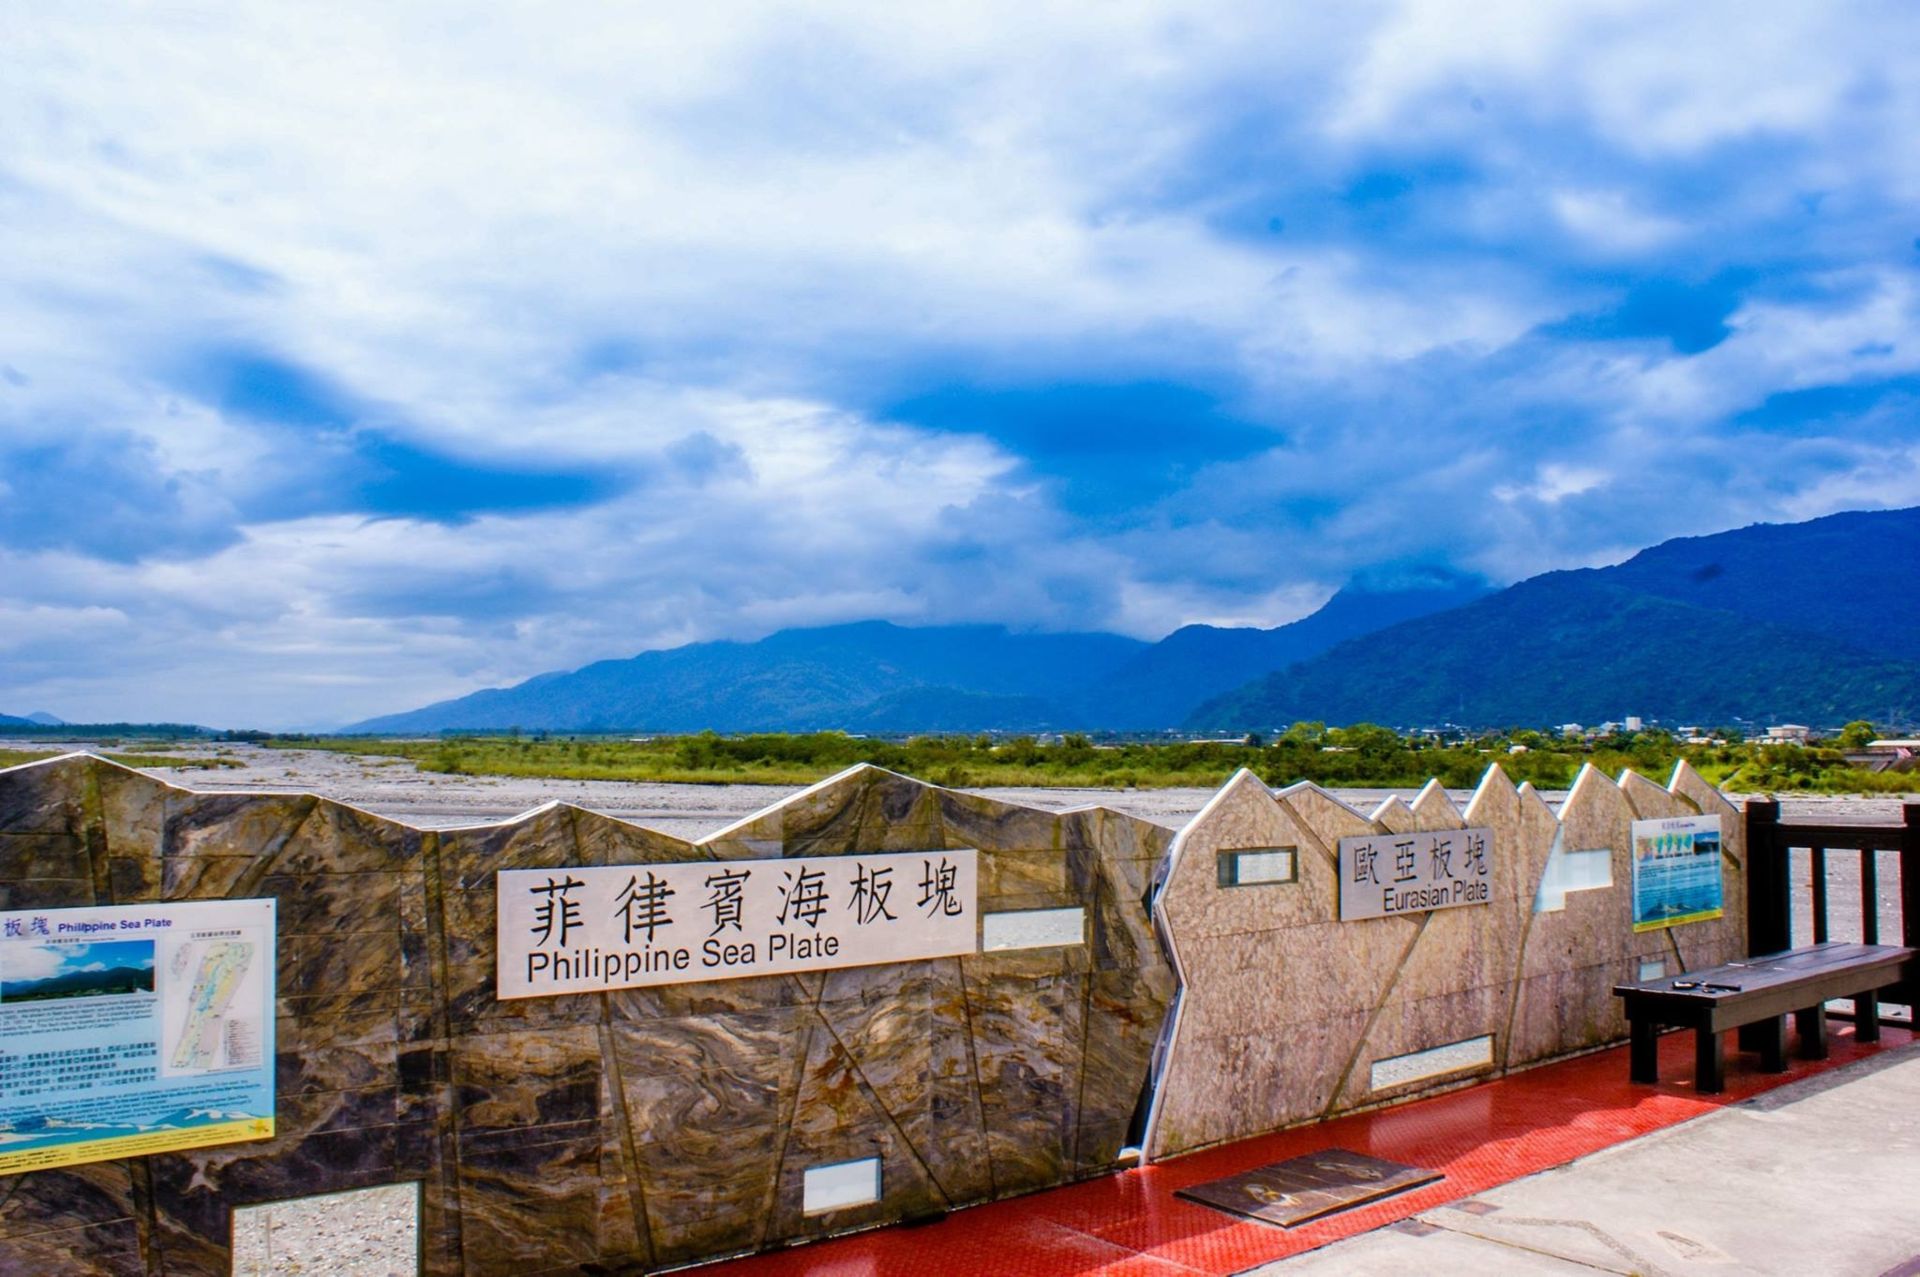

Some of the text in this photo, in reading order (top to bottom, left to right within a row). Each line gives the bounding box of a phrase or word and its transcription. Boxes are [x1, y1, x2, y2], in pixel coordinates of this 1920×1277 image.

[1353, 833, 1488, 885] 歐亞板塊
[528, 857, 963, 948] 菲律賓海板塊
[1384, 880, 1488, 912] Eurasian Plate
[120, 919, 141, 930] Sea
[144, 918, 172, 929] Plate
[528, 933, 839, 983] Philippine Sea Plate
